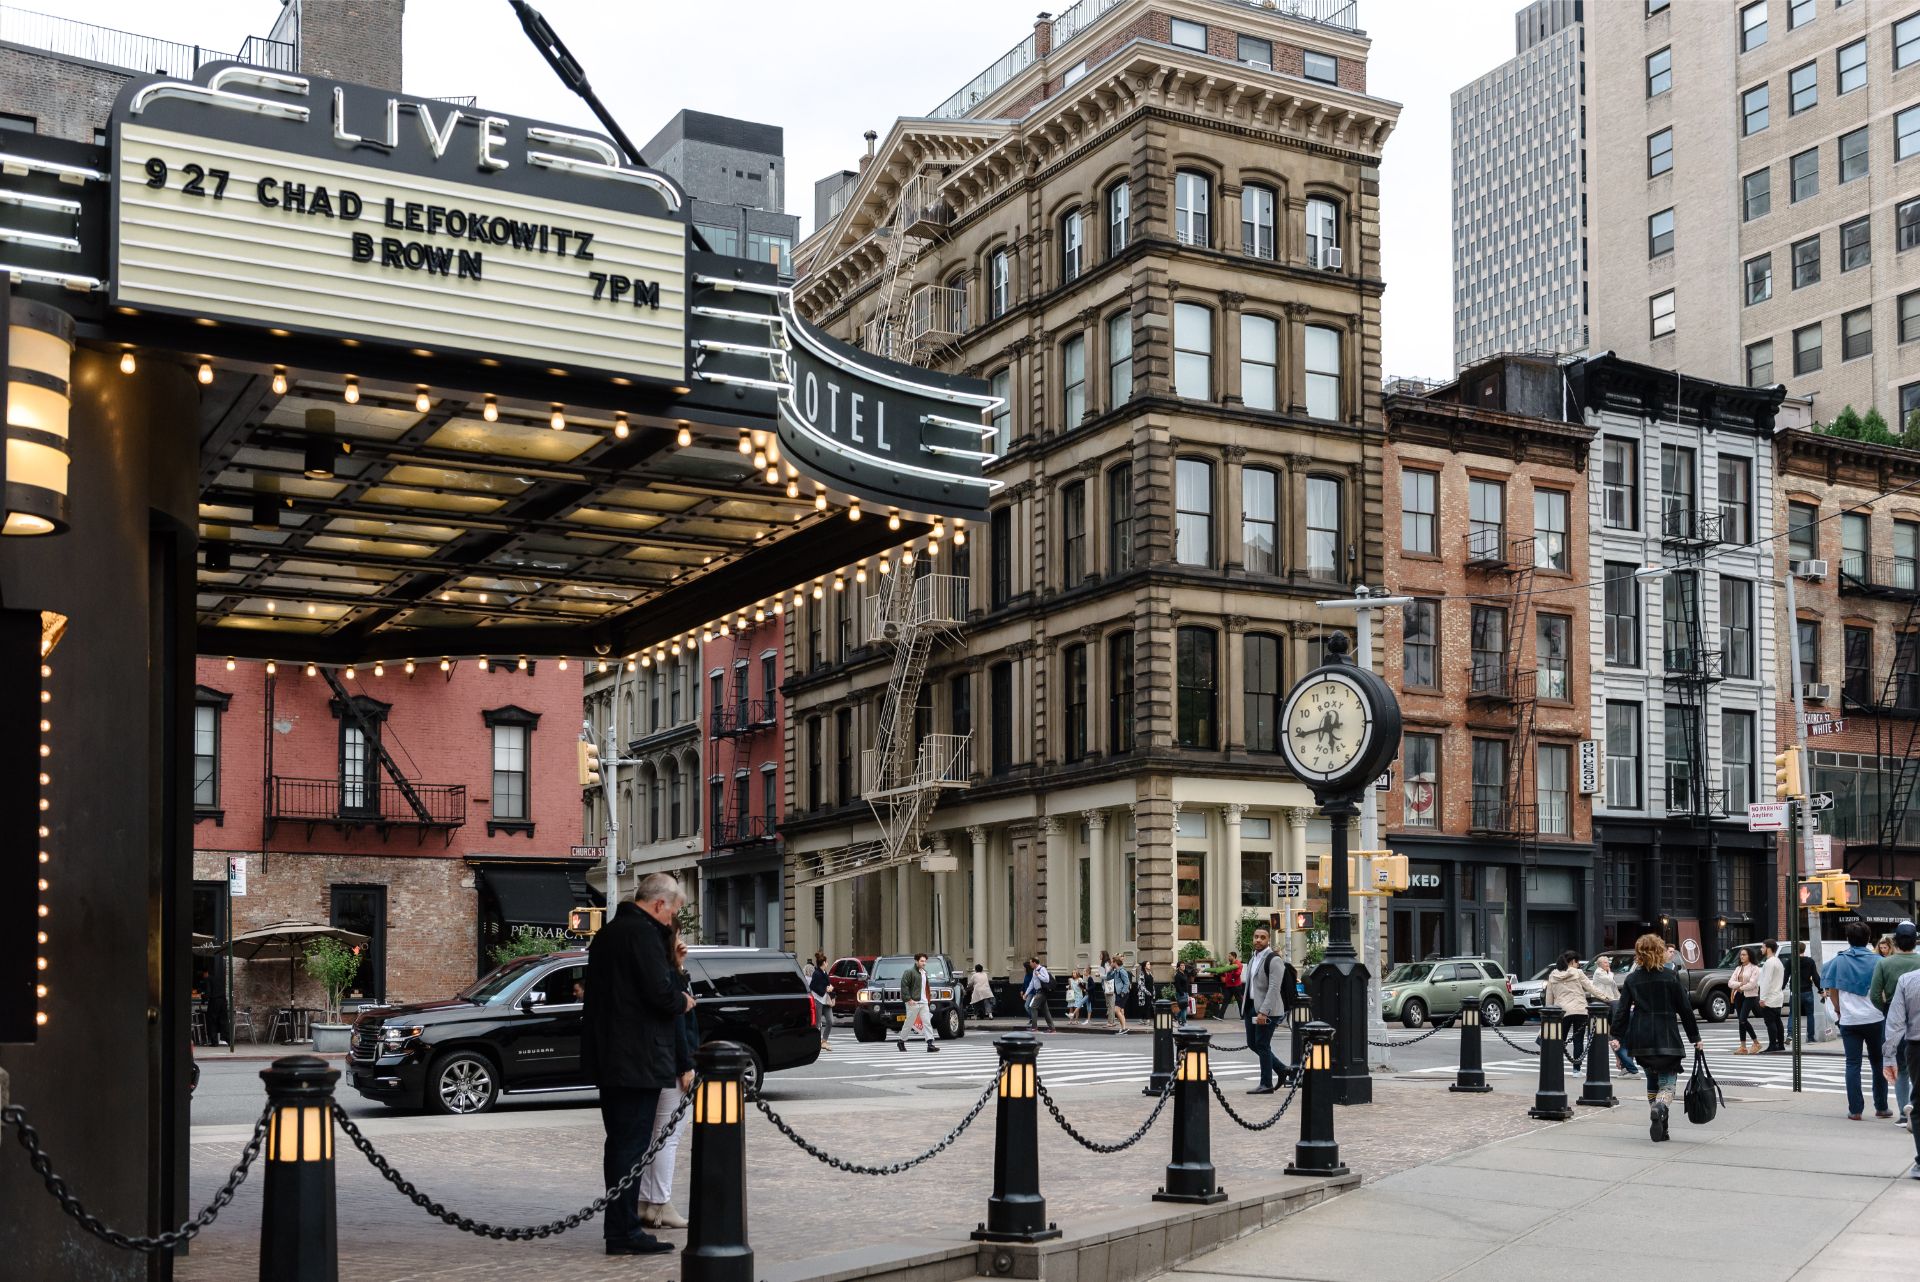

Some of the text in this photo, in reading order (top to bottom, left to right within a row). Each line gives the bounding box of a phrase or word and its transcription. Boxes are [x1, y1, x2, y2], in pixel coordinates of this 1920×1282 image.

[333, 86, 510, 169] LIVE
[257, 177, 363, 221] CHAD
[384, 198, 595, 261] LEFOKOWITZ
[589, 271, 660, 309] 7PM
[1325, 685, 1336, 695] 12
[1311, 694, 1320, 703] 11
[1317, 700, 1344, 712] ROXY
[1355, 700, 1361, 709] 2
[1300, 709, 1310, 718] 10
[1811, 721, 1843, 735] WHITE ST
[1355, 739, 1361, 748] 4
[1300, 745, 1306, 754] 8
[1315, 743, 1346, 755] HOEL
[1313, 756, 1319, 766] 7
[1344, 754, 1350, 763] 5
[1328, 761, 1334, 770] 6
[1811, 797, 1827, 805] WAY
[571, 847, 606, 857] CHURCH ST
[1408, 874, 1440, 887] KED
[1867, 885, 1902, 897] PIZZA
